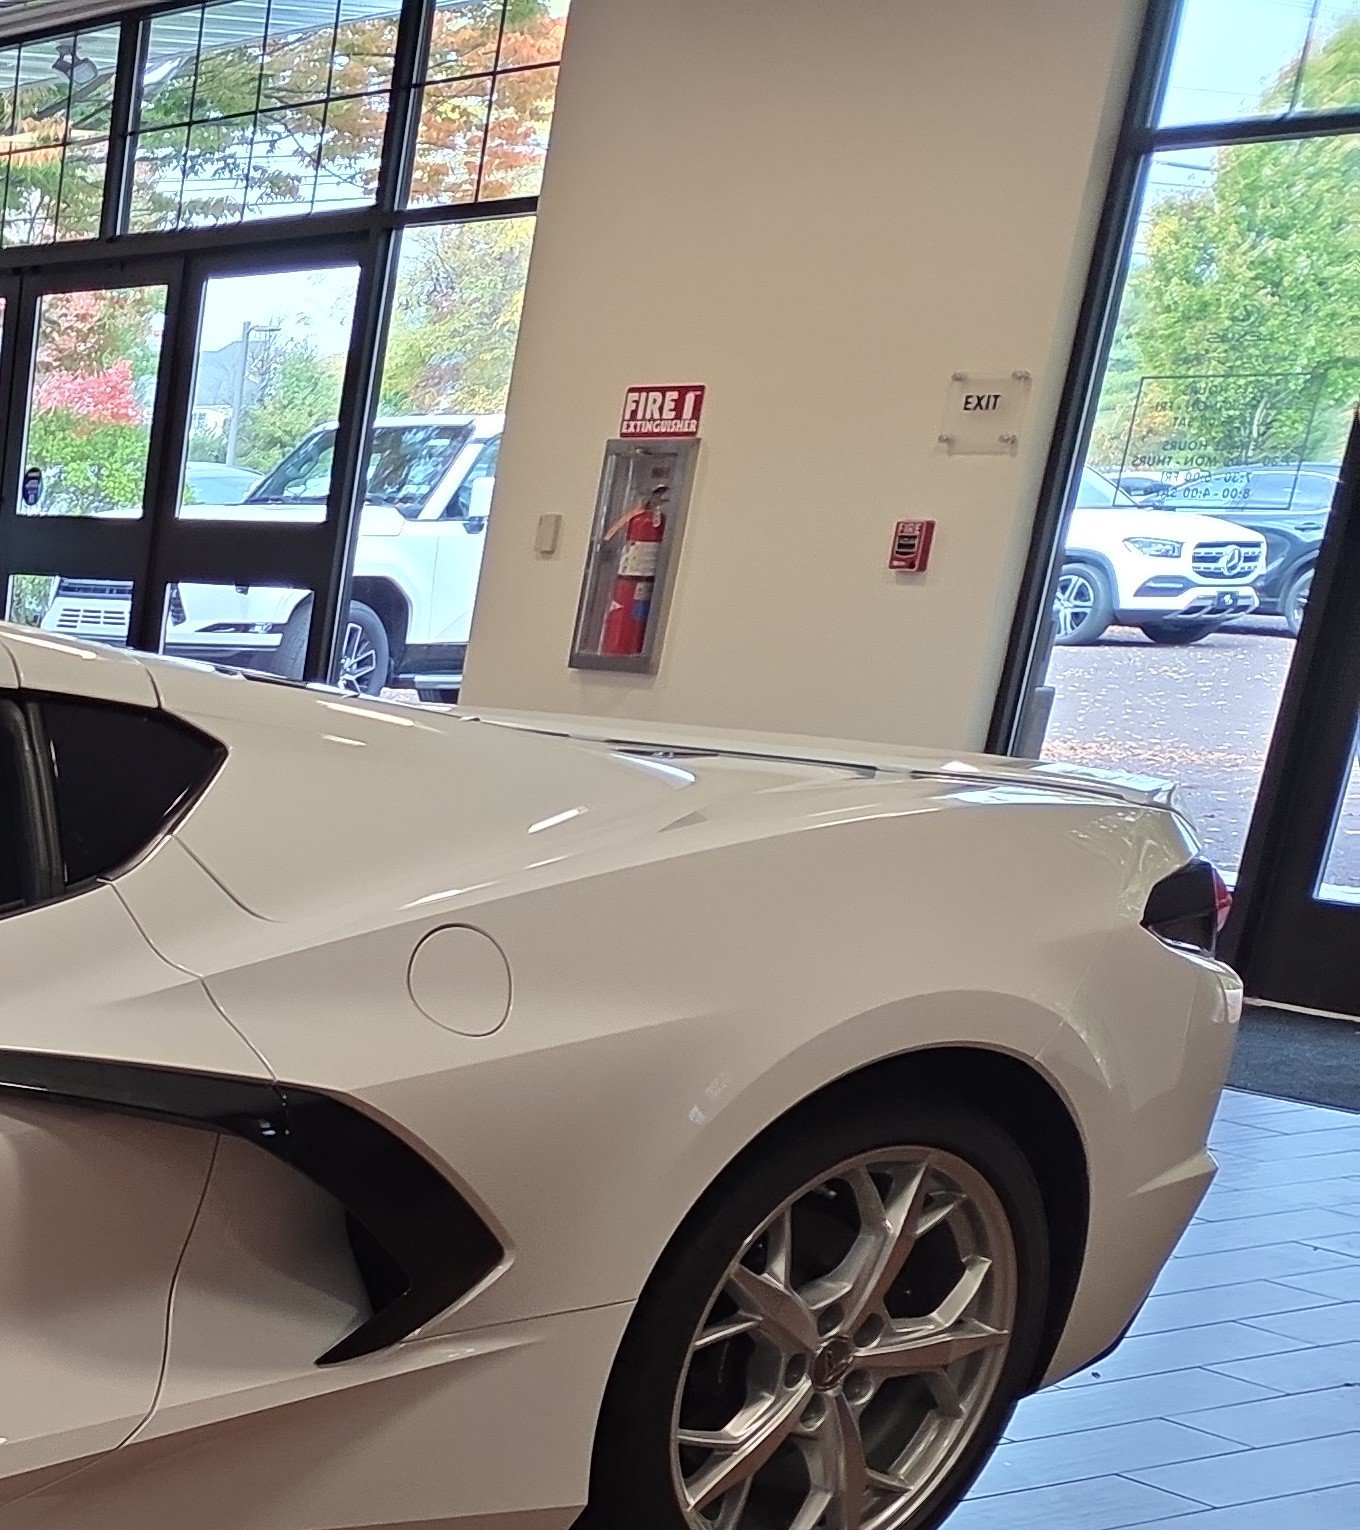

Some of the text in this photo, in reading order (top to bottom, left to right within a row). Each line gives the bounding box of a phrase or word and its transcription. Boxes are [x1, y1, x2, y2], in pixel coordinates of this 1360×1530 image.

[624, 391, 680, 419] FIRE
[963, 394, 1001, 411] EXIT
[621, 419, 698, 433] EXTINGUISHER
